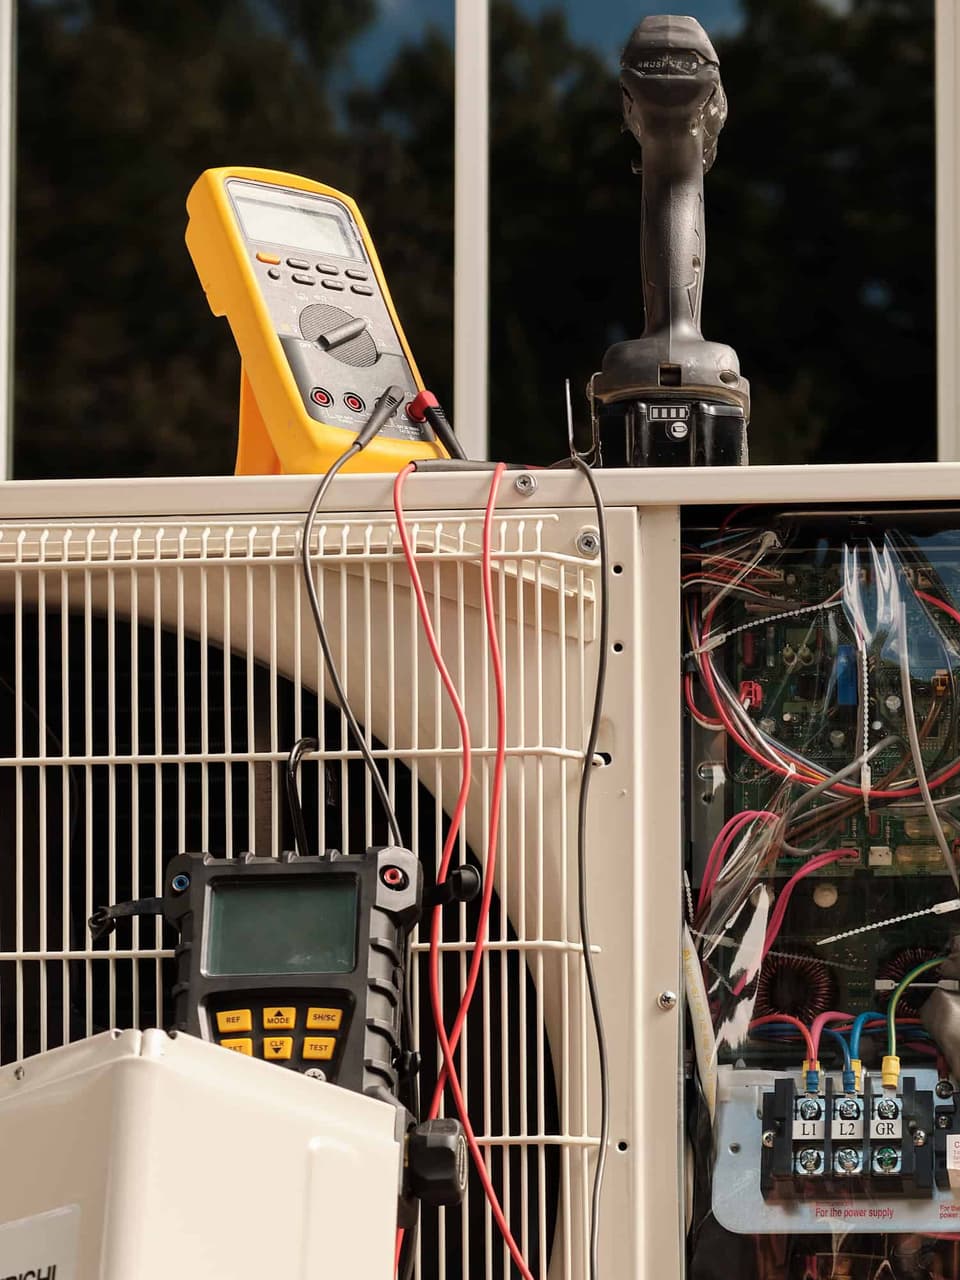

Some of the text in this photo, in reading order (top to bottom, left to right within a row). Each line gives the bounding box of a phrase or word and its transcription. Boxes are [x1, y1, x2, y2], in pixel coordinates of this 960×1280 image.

[226, 1016, 241, 1024] REF
[313, 1013, 336, 1021] SH/SC
[802, 1123, 816, 1136] L1
[840, 1123, 855, 1136] L2
[875, 1122, 895, 1136] GR
[815, 1207, 894, 1220] For the power supply
